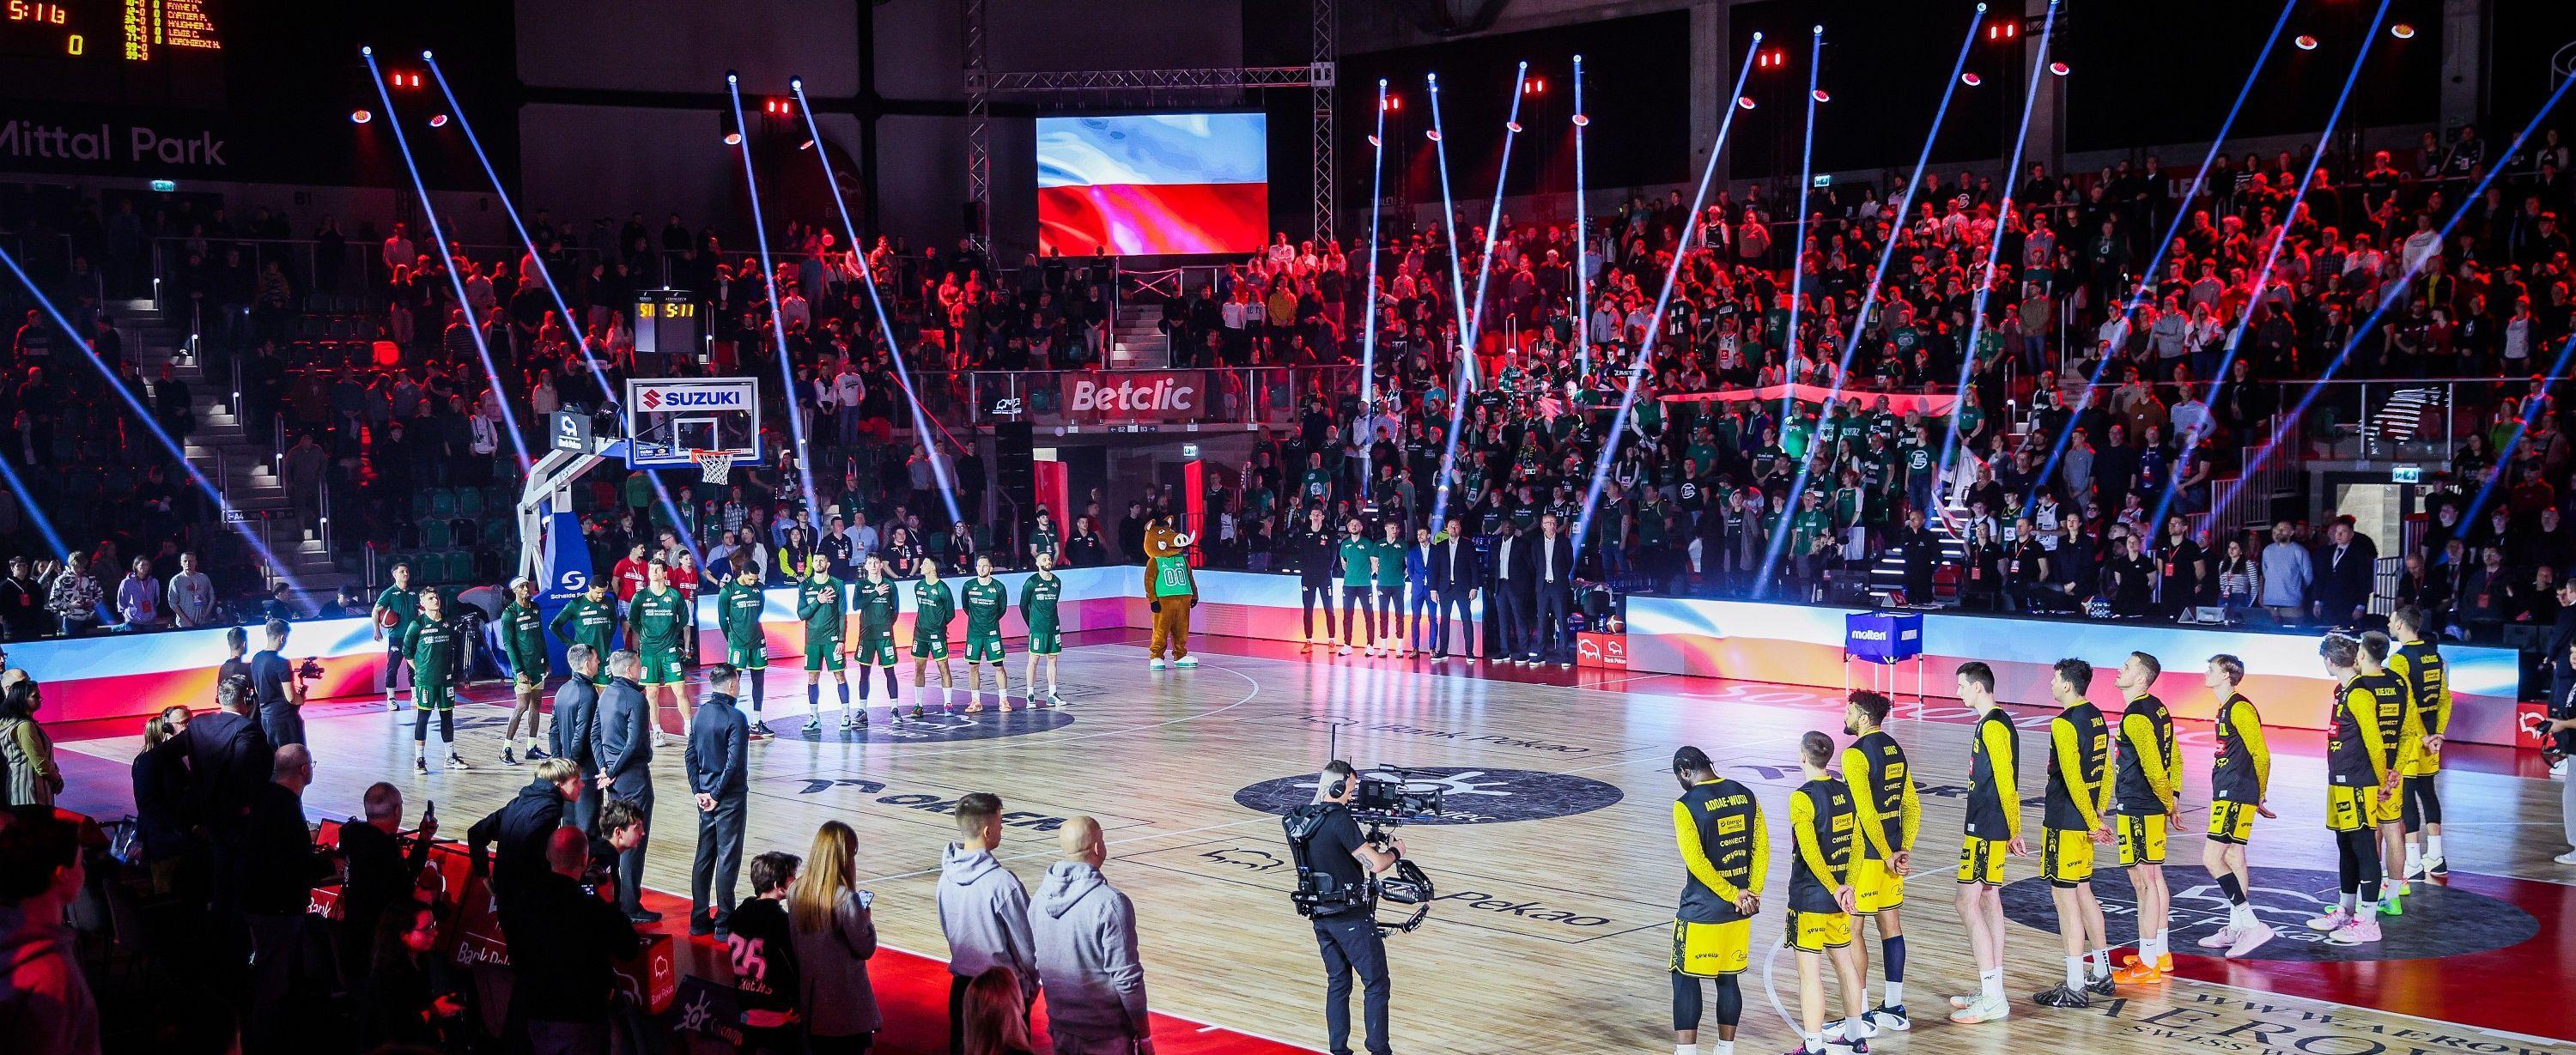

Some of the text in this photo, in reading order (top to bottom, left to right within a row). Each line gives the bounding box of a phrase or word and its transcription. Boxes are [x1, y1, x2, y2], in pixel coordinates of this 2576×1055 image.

[131, 126, 227, 166] Park
[665, 302, 695, 318] 5:11
[665, 391, 740, 406] SUZUKI
[1071, 377, 1194, 411] Betclic
[1163, 567, 1187, 587] 00
[1851, 629, 1887, 641] molten
[1884, 782, 1902, 791] CONNEC
[1704, 794, 1748, 812] ADDAE-WUSU
[1884, 794, 1900, 807] SPYGU
[1432, 890, 1610, 926] Pekao
[2087, 997, 2440, 1055] AERO
[2123, 1024, 2251, 1052] SWISS
